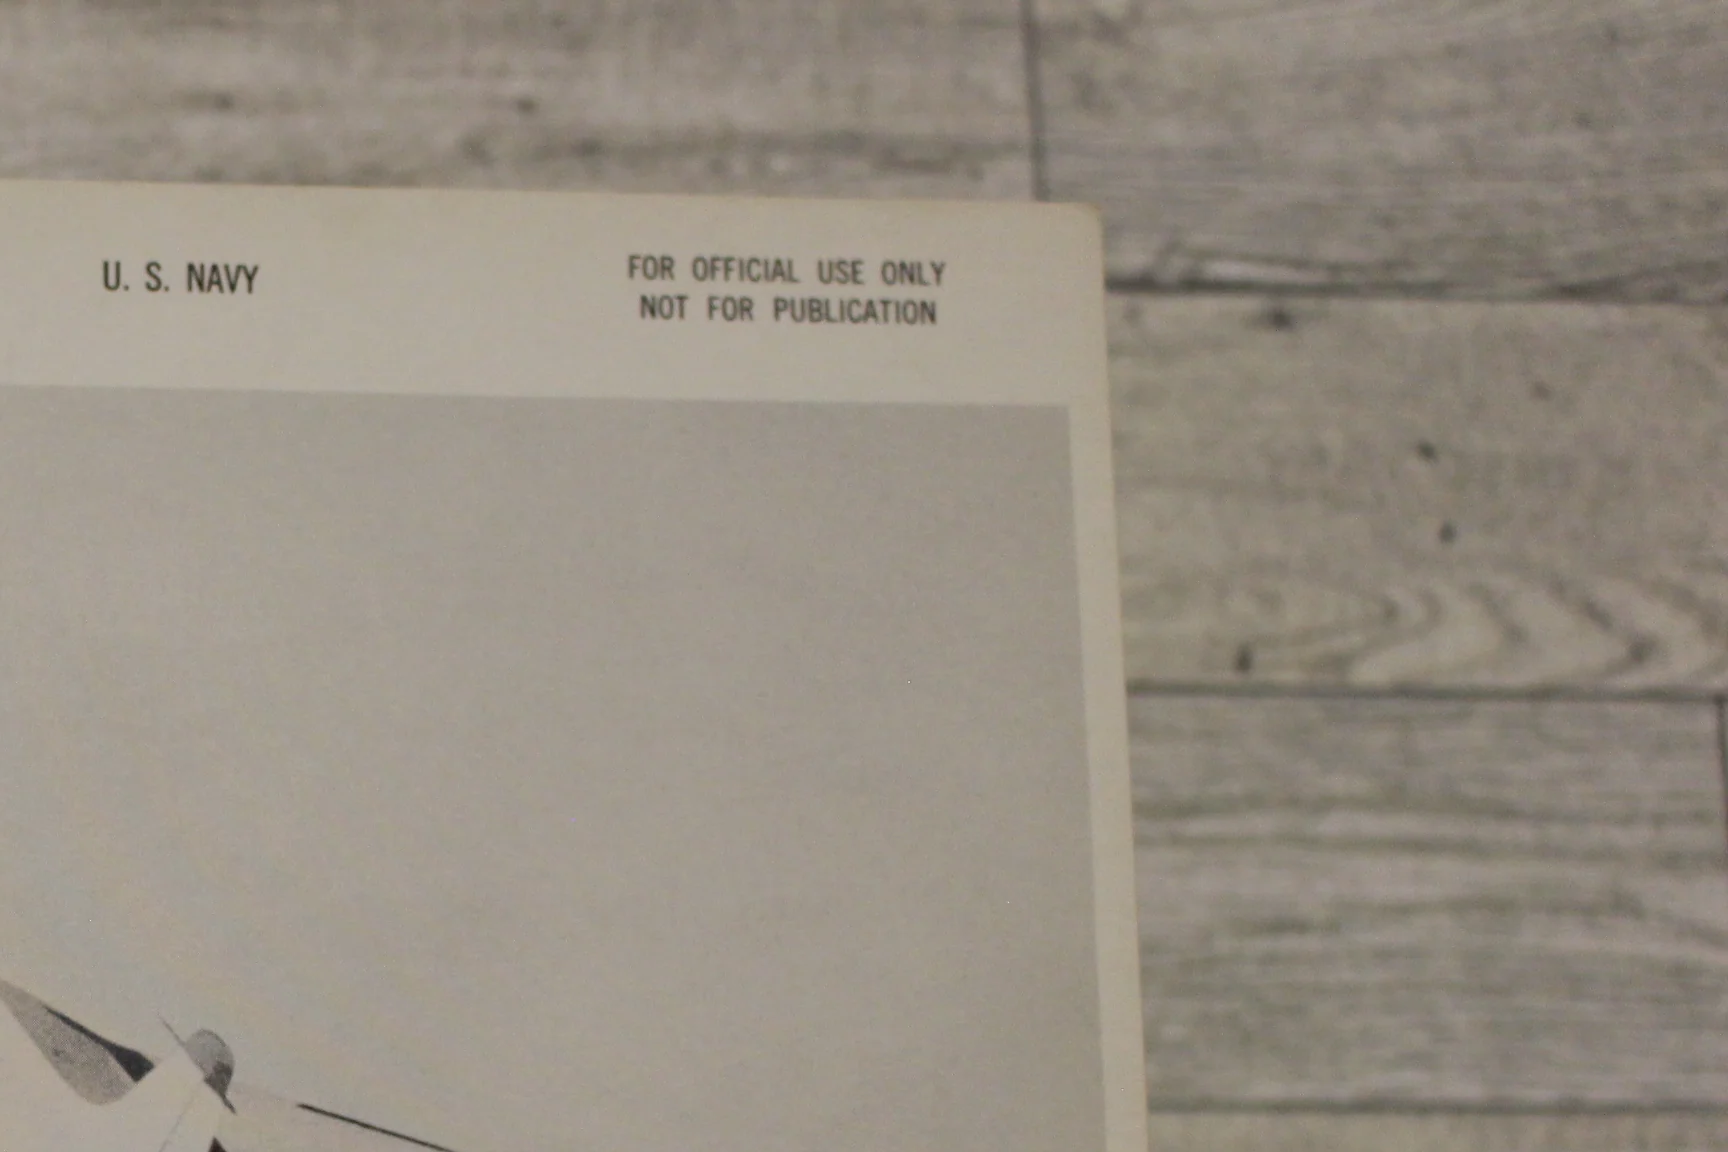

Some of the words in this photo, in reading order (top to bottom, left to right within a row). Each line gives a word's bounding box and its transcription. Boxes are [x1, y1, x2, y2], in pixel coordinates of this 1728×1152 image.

[102, 260, 130, 292] U.
[145, 261, 170, 293] S.
[186, 262, 259, 294] NAVY
[627, 254, 675, 281] FOR
[692, 256, 798, 284] OFFICIAL
[817, 260, 864, 286] USE
[880, 260, 946, 287] ONLY
[639, 294, 689, 320] NOT
[707, 295, 755, 322] FOR
[773, 297, 937, 325] PUBLICATION
